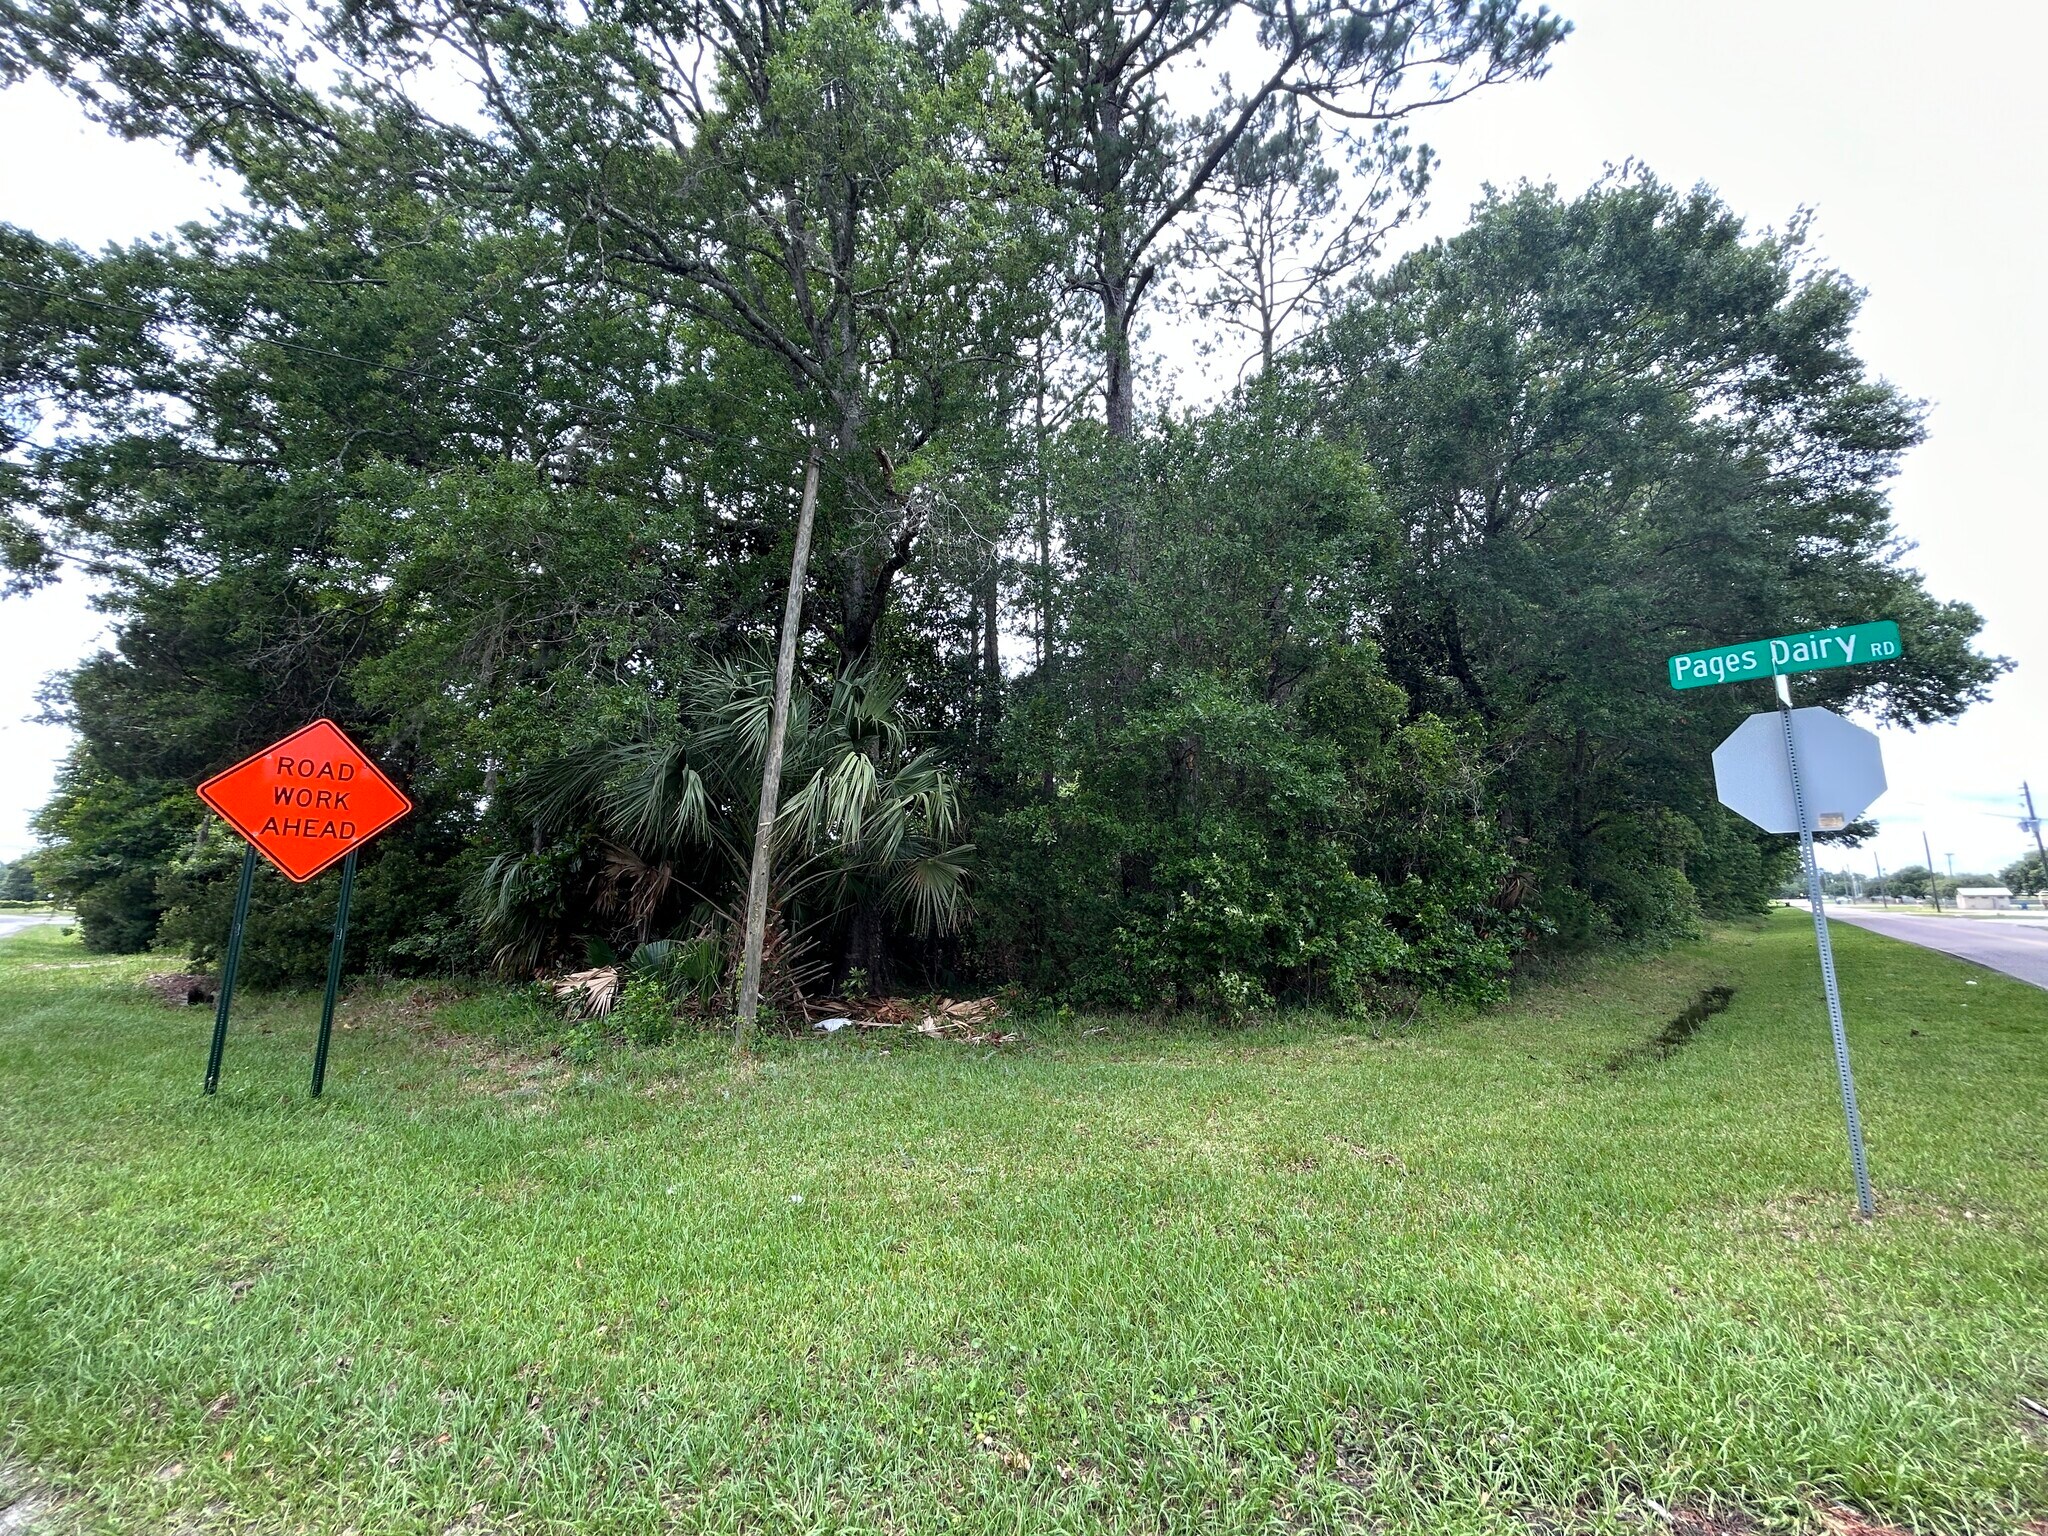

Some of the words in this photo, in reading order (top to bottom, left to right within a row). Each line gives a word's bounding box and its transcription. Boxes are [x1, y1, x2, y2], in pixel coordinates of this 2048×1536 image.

[1674, 649, 1758, 683] Pages
[1769, 634, 1857, 665] Dairy
[1870, 641, 1895, 657] RD
[276, 756, 355, 782] ROAD
[274, 786, 351, 811] WORK
[259, 816, 356, 840] AHEAD
